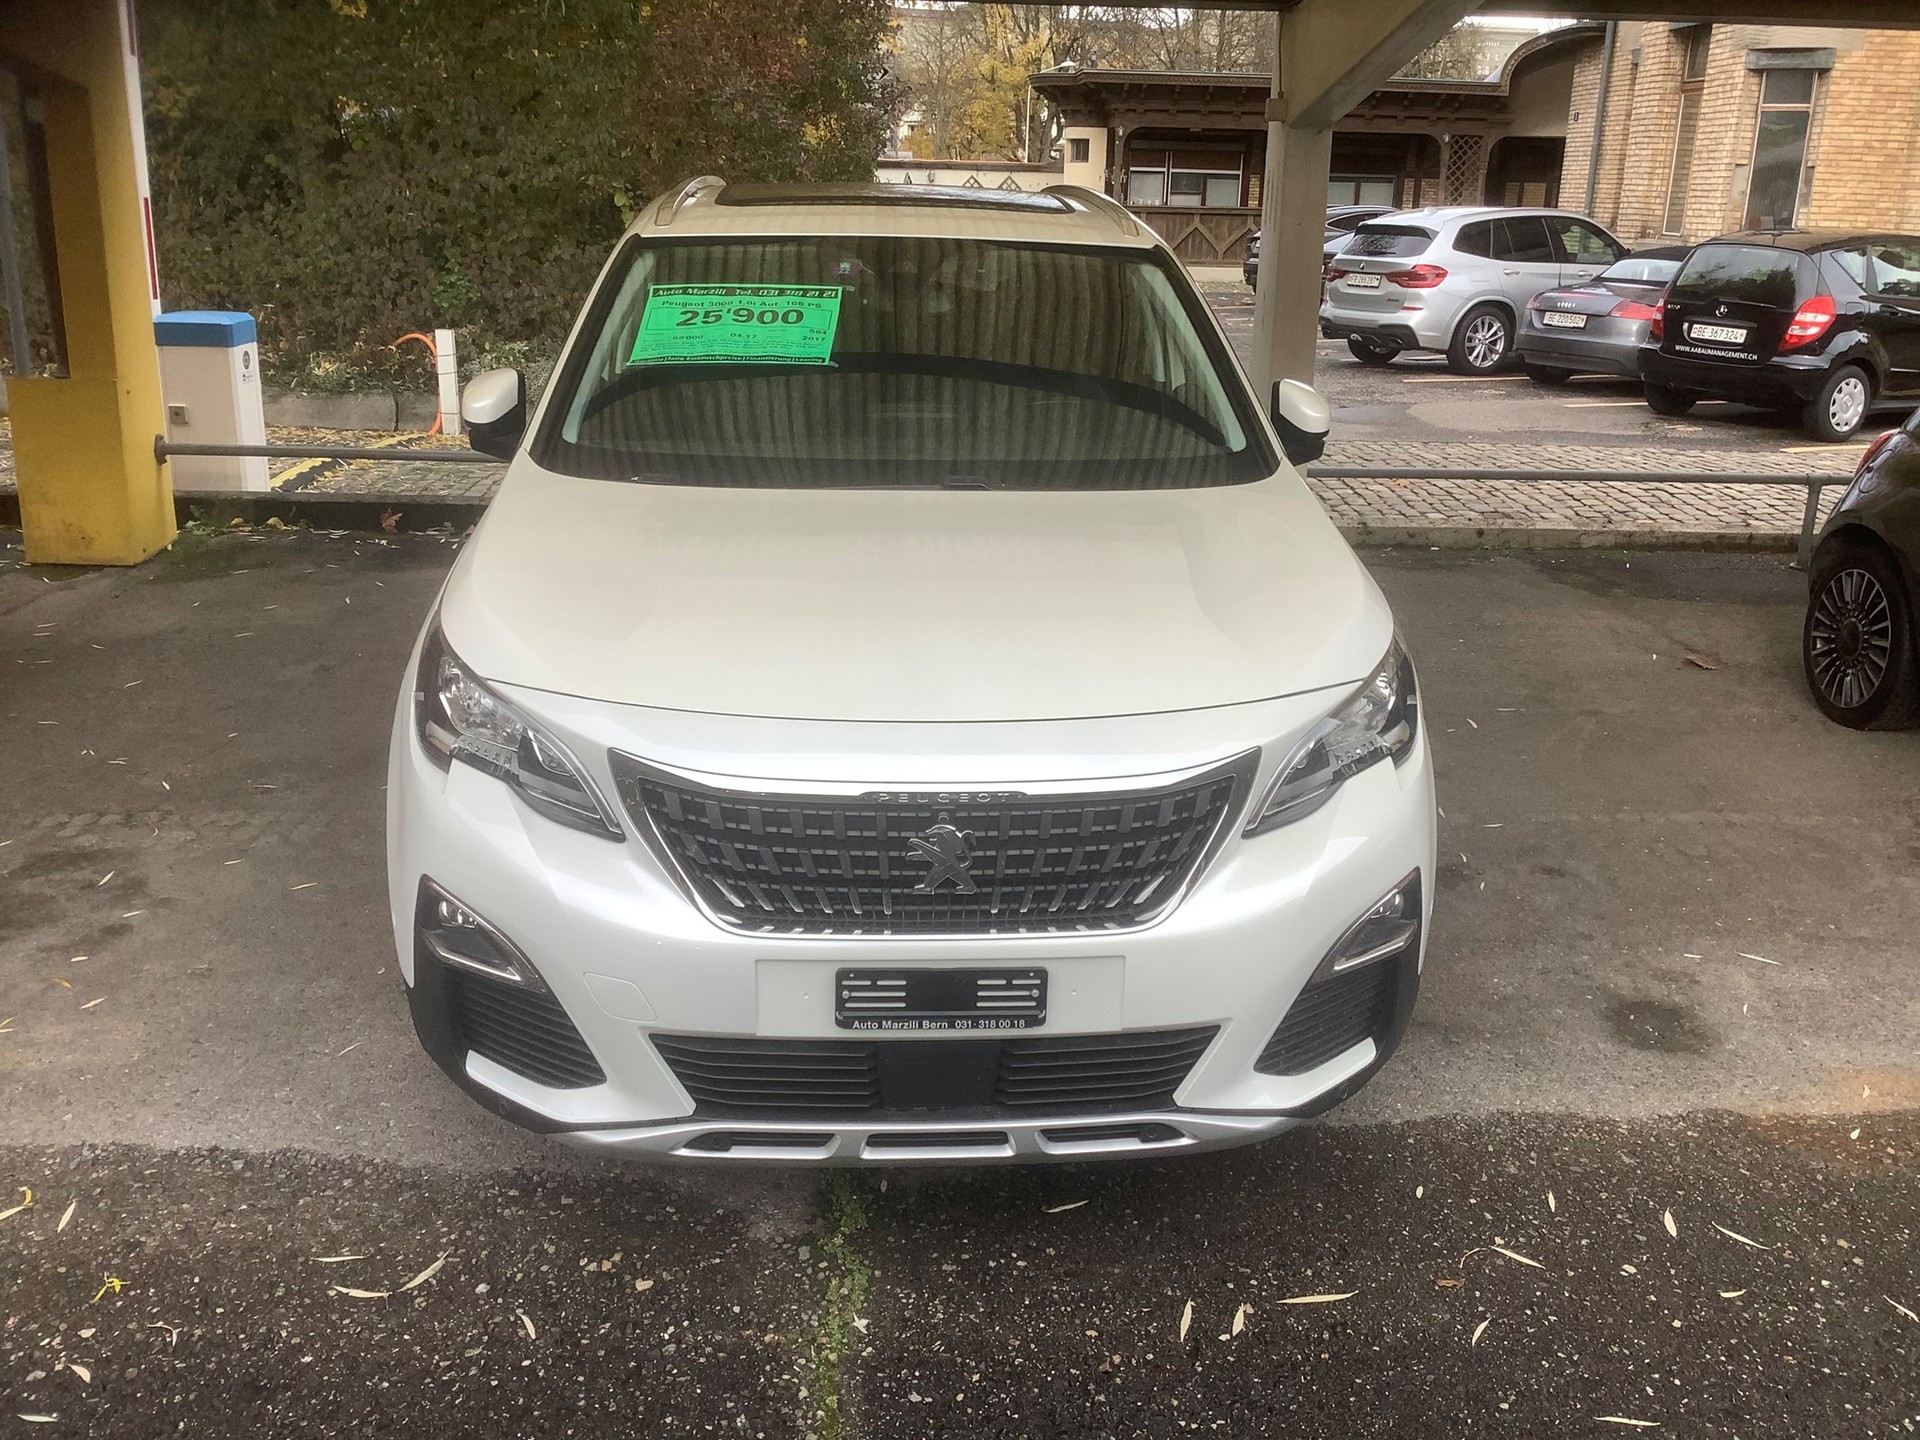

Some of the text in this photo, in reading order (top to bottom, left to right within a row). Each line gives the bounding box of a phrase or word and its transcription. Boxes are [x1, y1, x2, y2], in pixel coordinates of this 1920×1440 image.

[655, 288, 682, 296] Auto
[823, 290, 836, 298] 21
[676, 307, 805, 327] 25'900
[1697, 327, 1738, 340] BE 367324
[1675, 345, 1758, 361] WWW.AABAUMANAGEMENT.CH
[878, 793, 1009, 803] PEUGEOT
[853, 1020, 879, 1029] Auto
[882, 1020, 919, 1029] Marzili
[922, 1020, 949, 1030] Bern
[999, 1019, 1011, 1028] 00
[1014, 1019, 1026, 1028] 18
